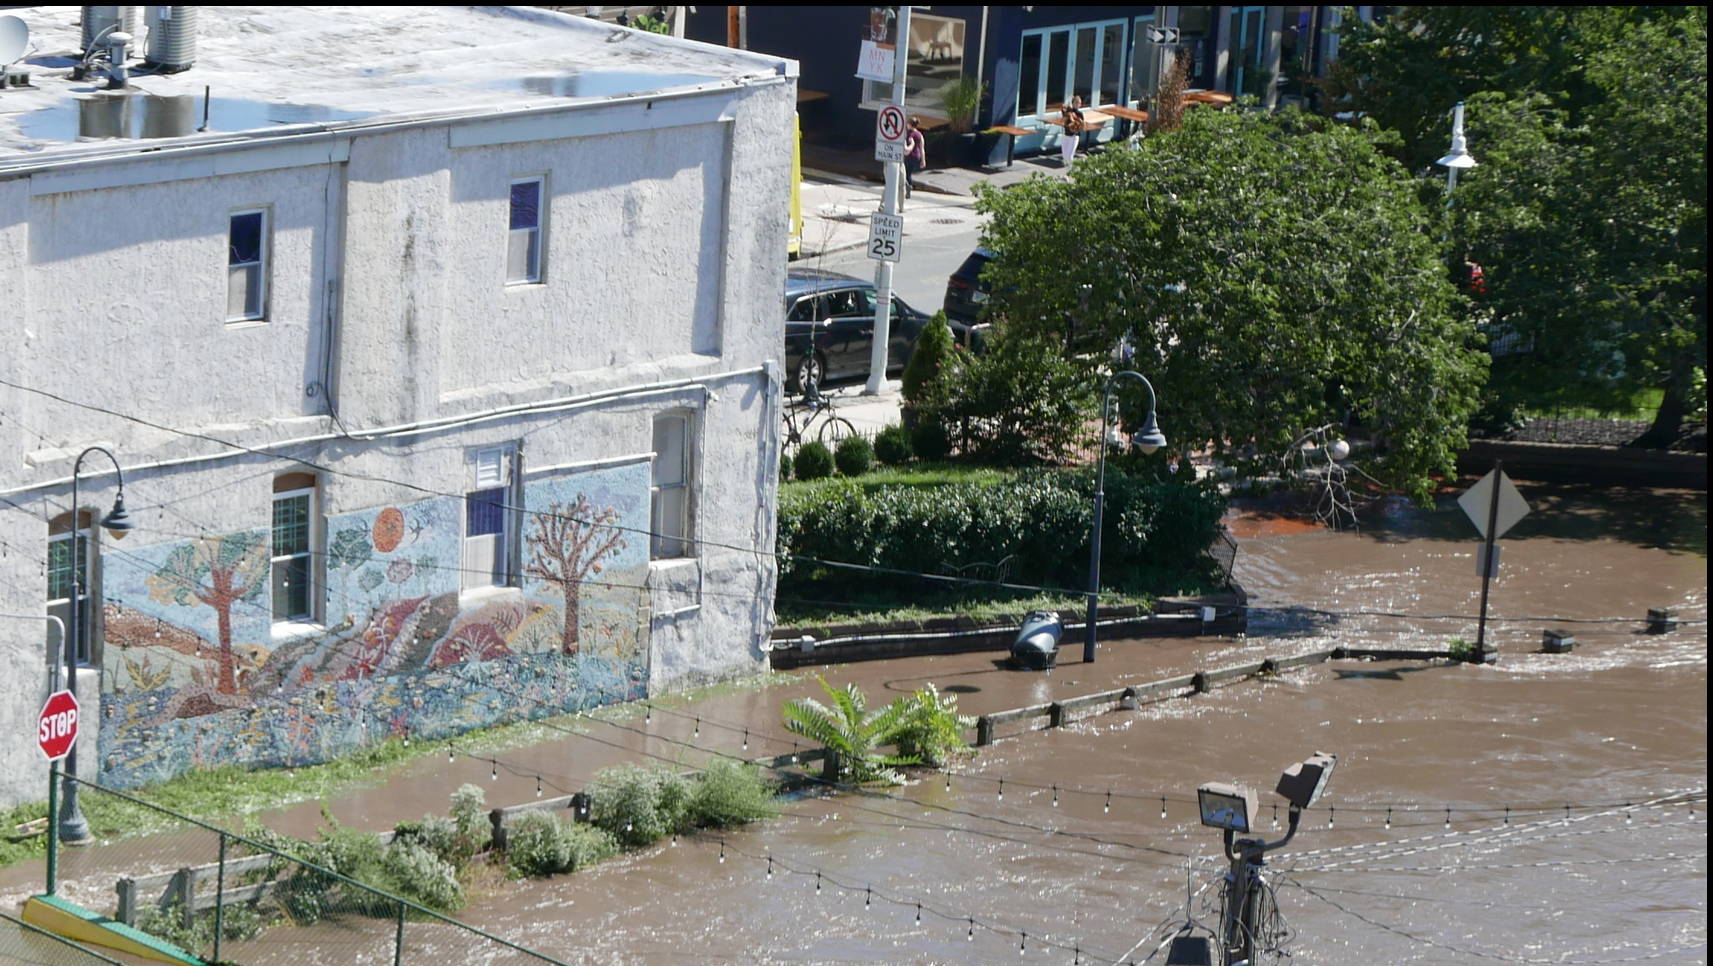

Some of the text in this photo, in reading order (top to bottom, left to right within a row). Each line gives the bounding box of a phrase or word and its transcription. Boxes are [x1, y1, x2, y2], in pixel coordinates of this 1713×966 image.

[884, 143, 893, 152] ON
[873, 216, 900, 229] SPEED
[874, 227, 896, 237] LIMIT
[872, 238, 896, 257] 25
[40, 709, 77, 743] STOP
